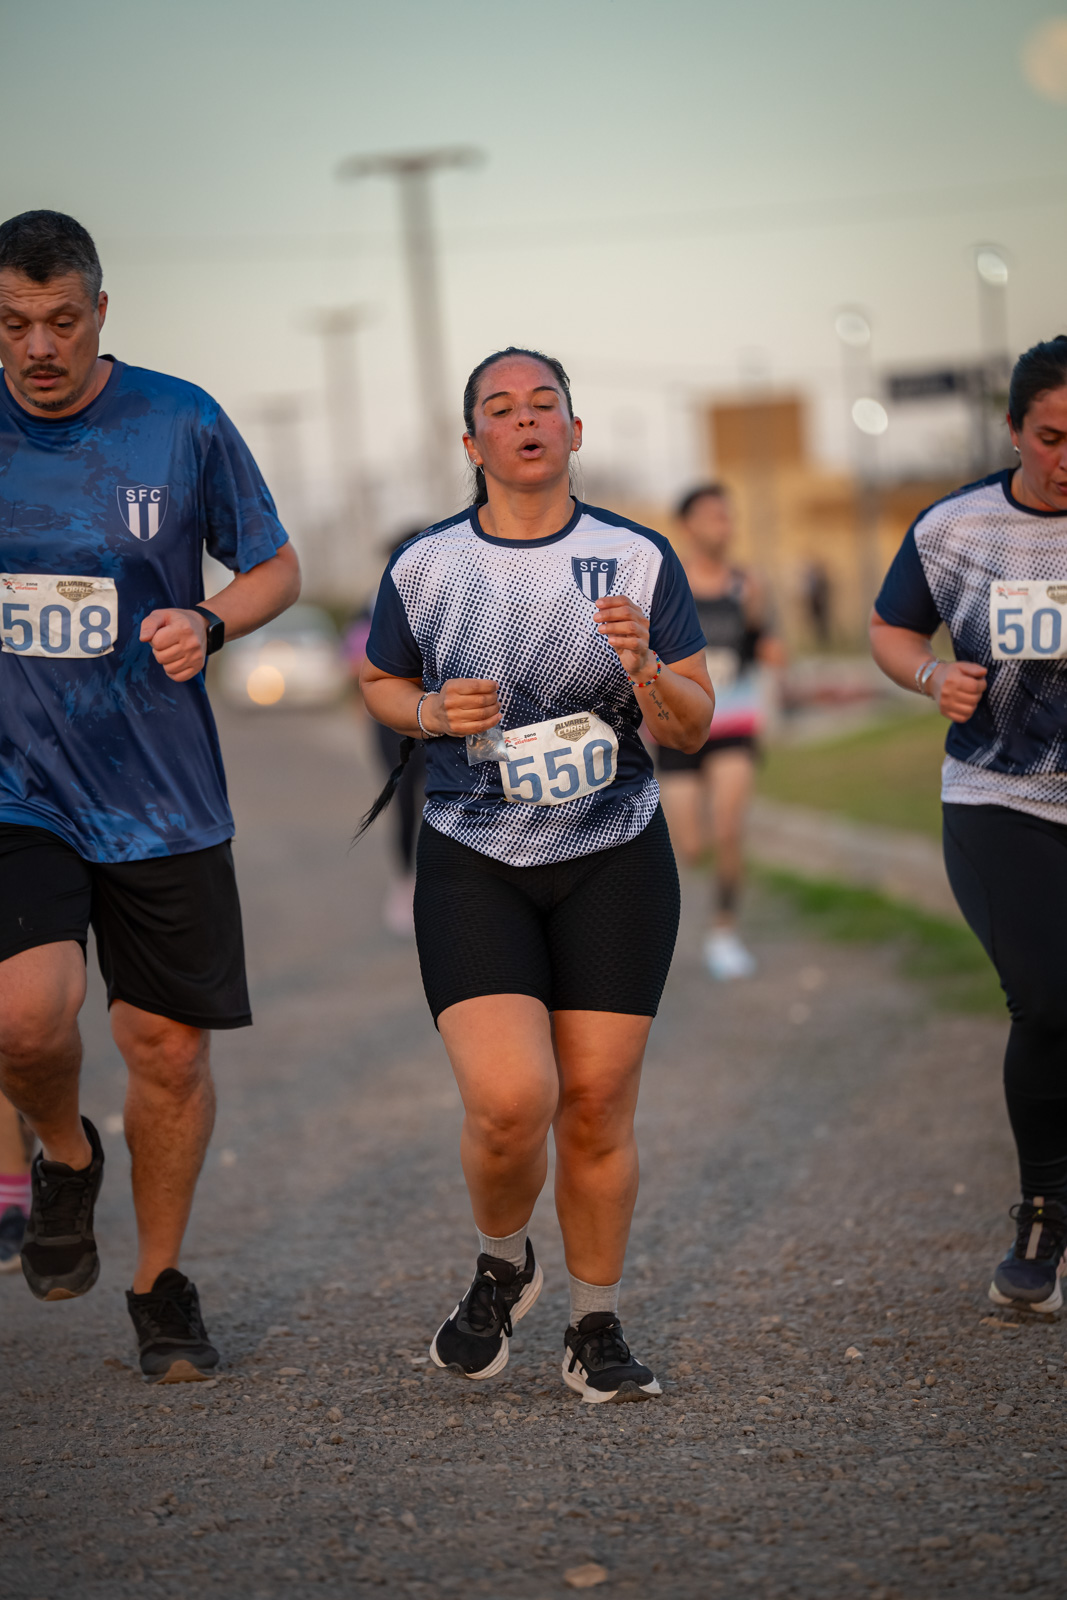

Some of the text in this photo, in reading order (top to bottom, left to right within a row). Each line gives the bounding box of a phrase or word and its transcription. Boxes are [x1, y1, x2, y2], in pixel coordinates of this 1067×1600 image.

[126, 489, 161, 502] SFC
[580, 561, 609, 572] SFC
[2, 602, 112, 655] 508
[554, 716, 589, 731] ALVAREZ
[557, 722, 591, 737] CORRE
[506, 738, 613, 803] 550
